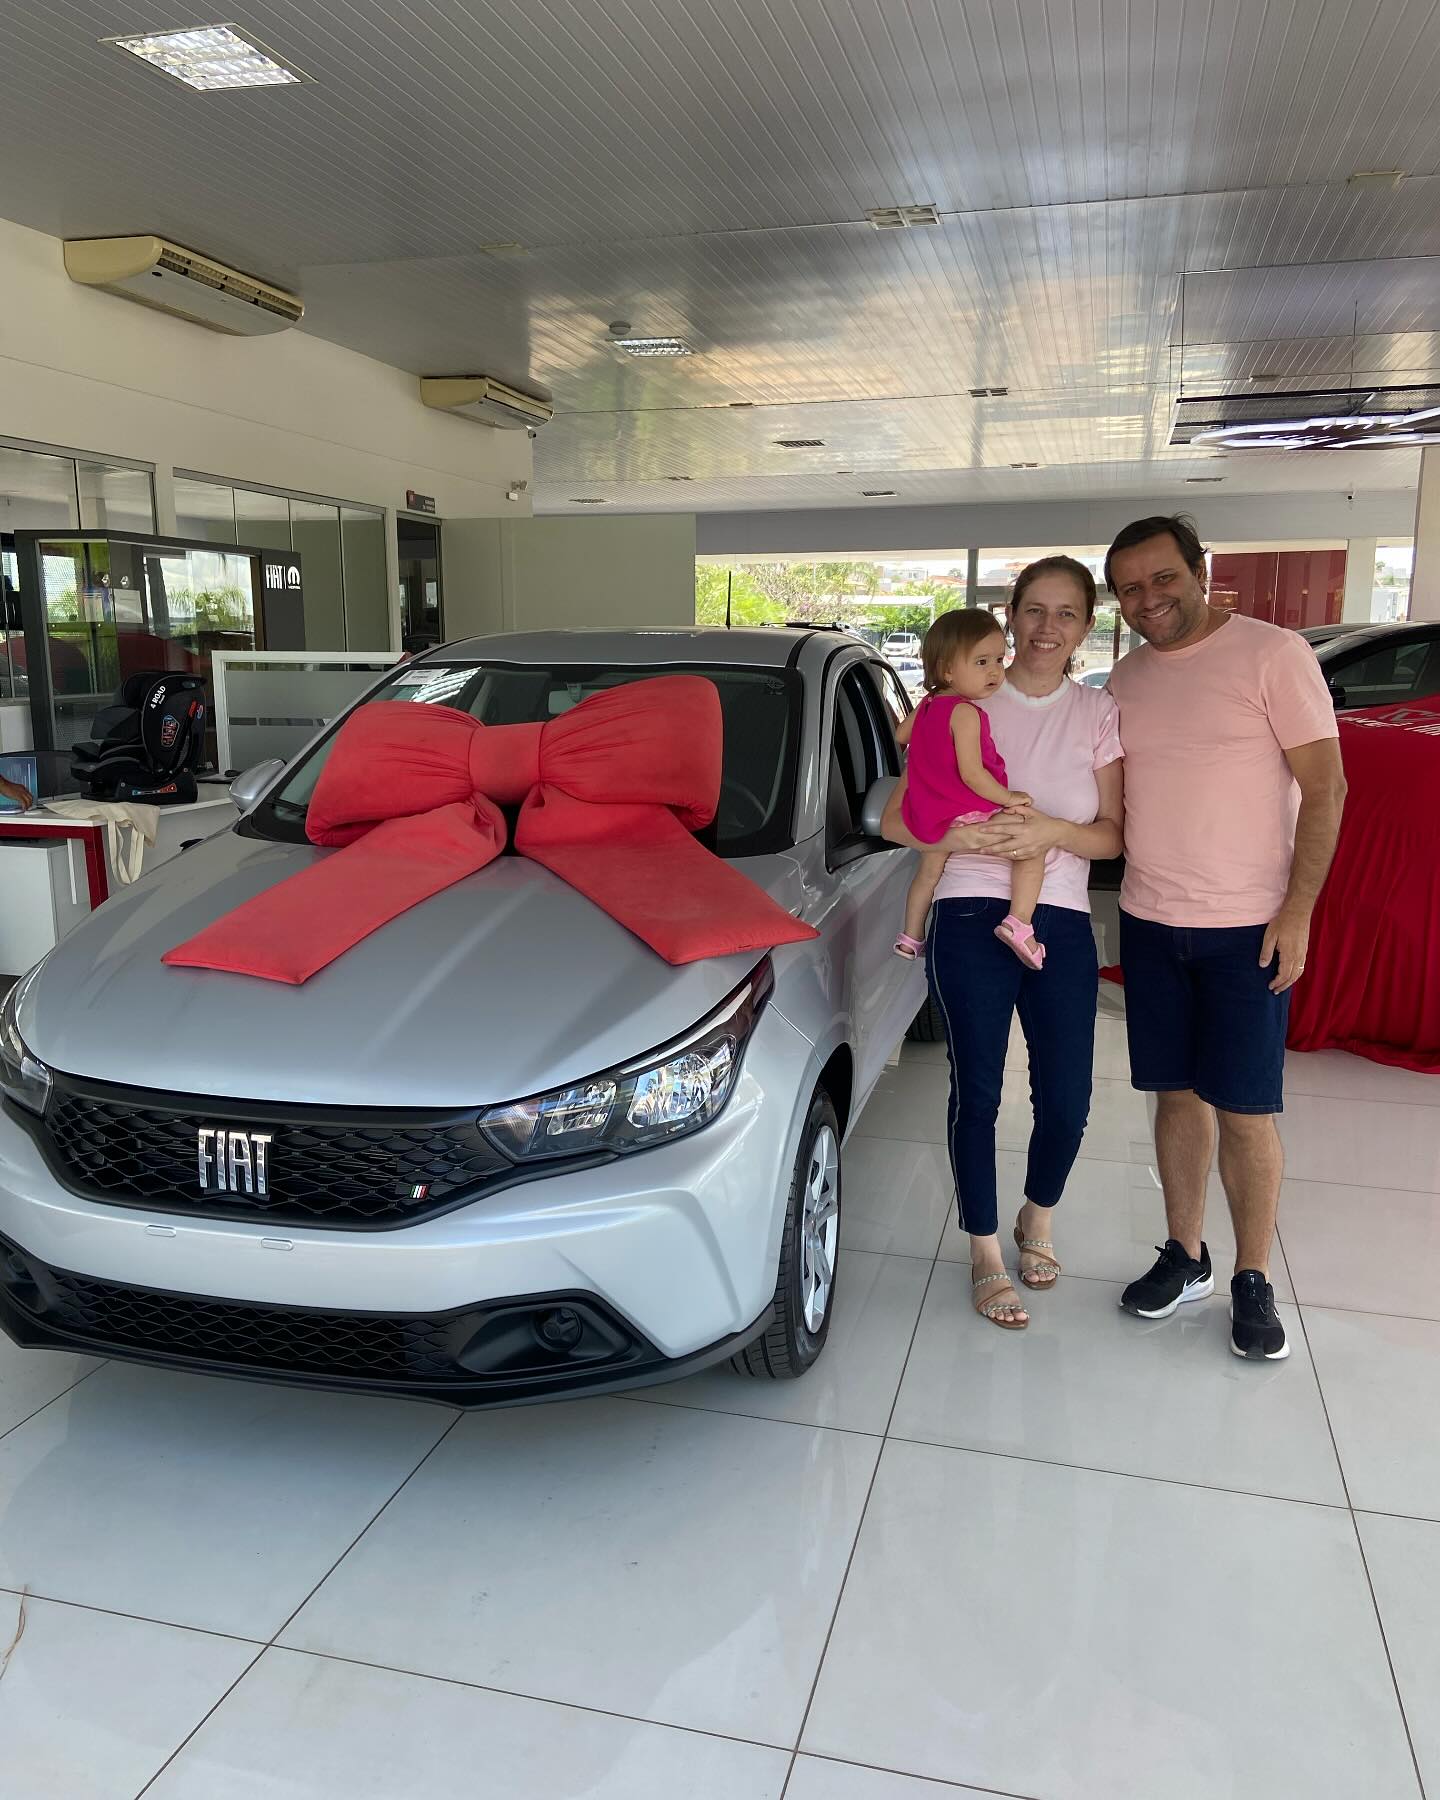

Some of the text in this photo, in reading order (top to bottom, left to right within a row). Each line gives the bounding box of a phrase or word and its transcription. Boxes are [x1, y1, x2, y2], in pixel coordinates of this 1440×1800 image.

[265, 564, 283, 589] FIAT
[151, 685, 166, 704] ROAD
[199, 1128, 272, 1194] FIAT
